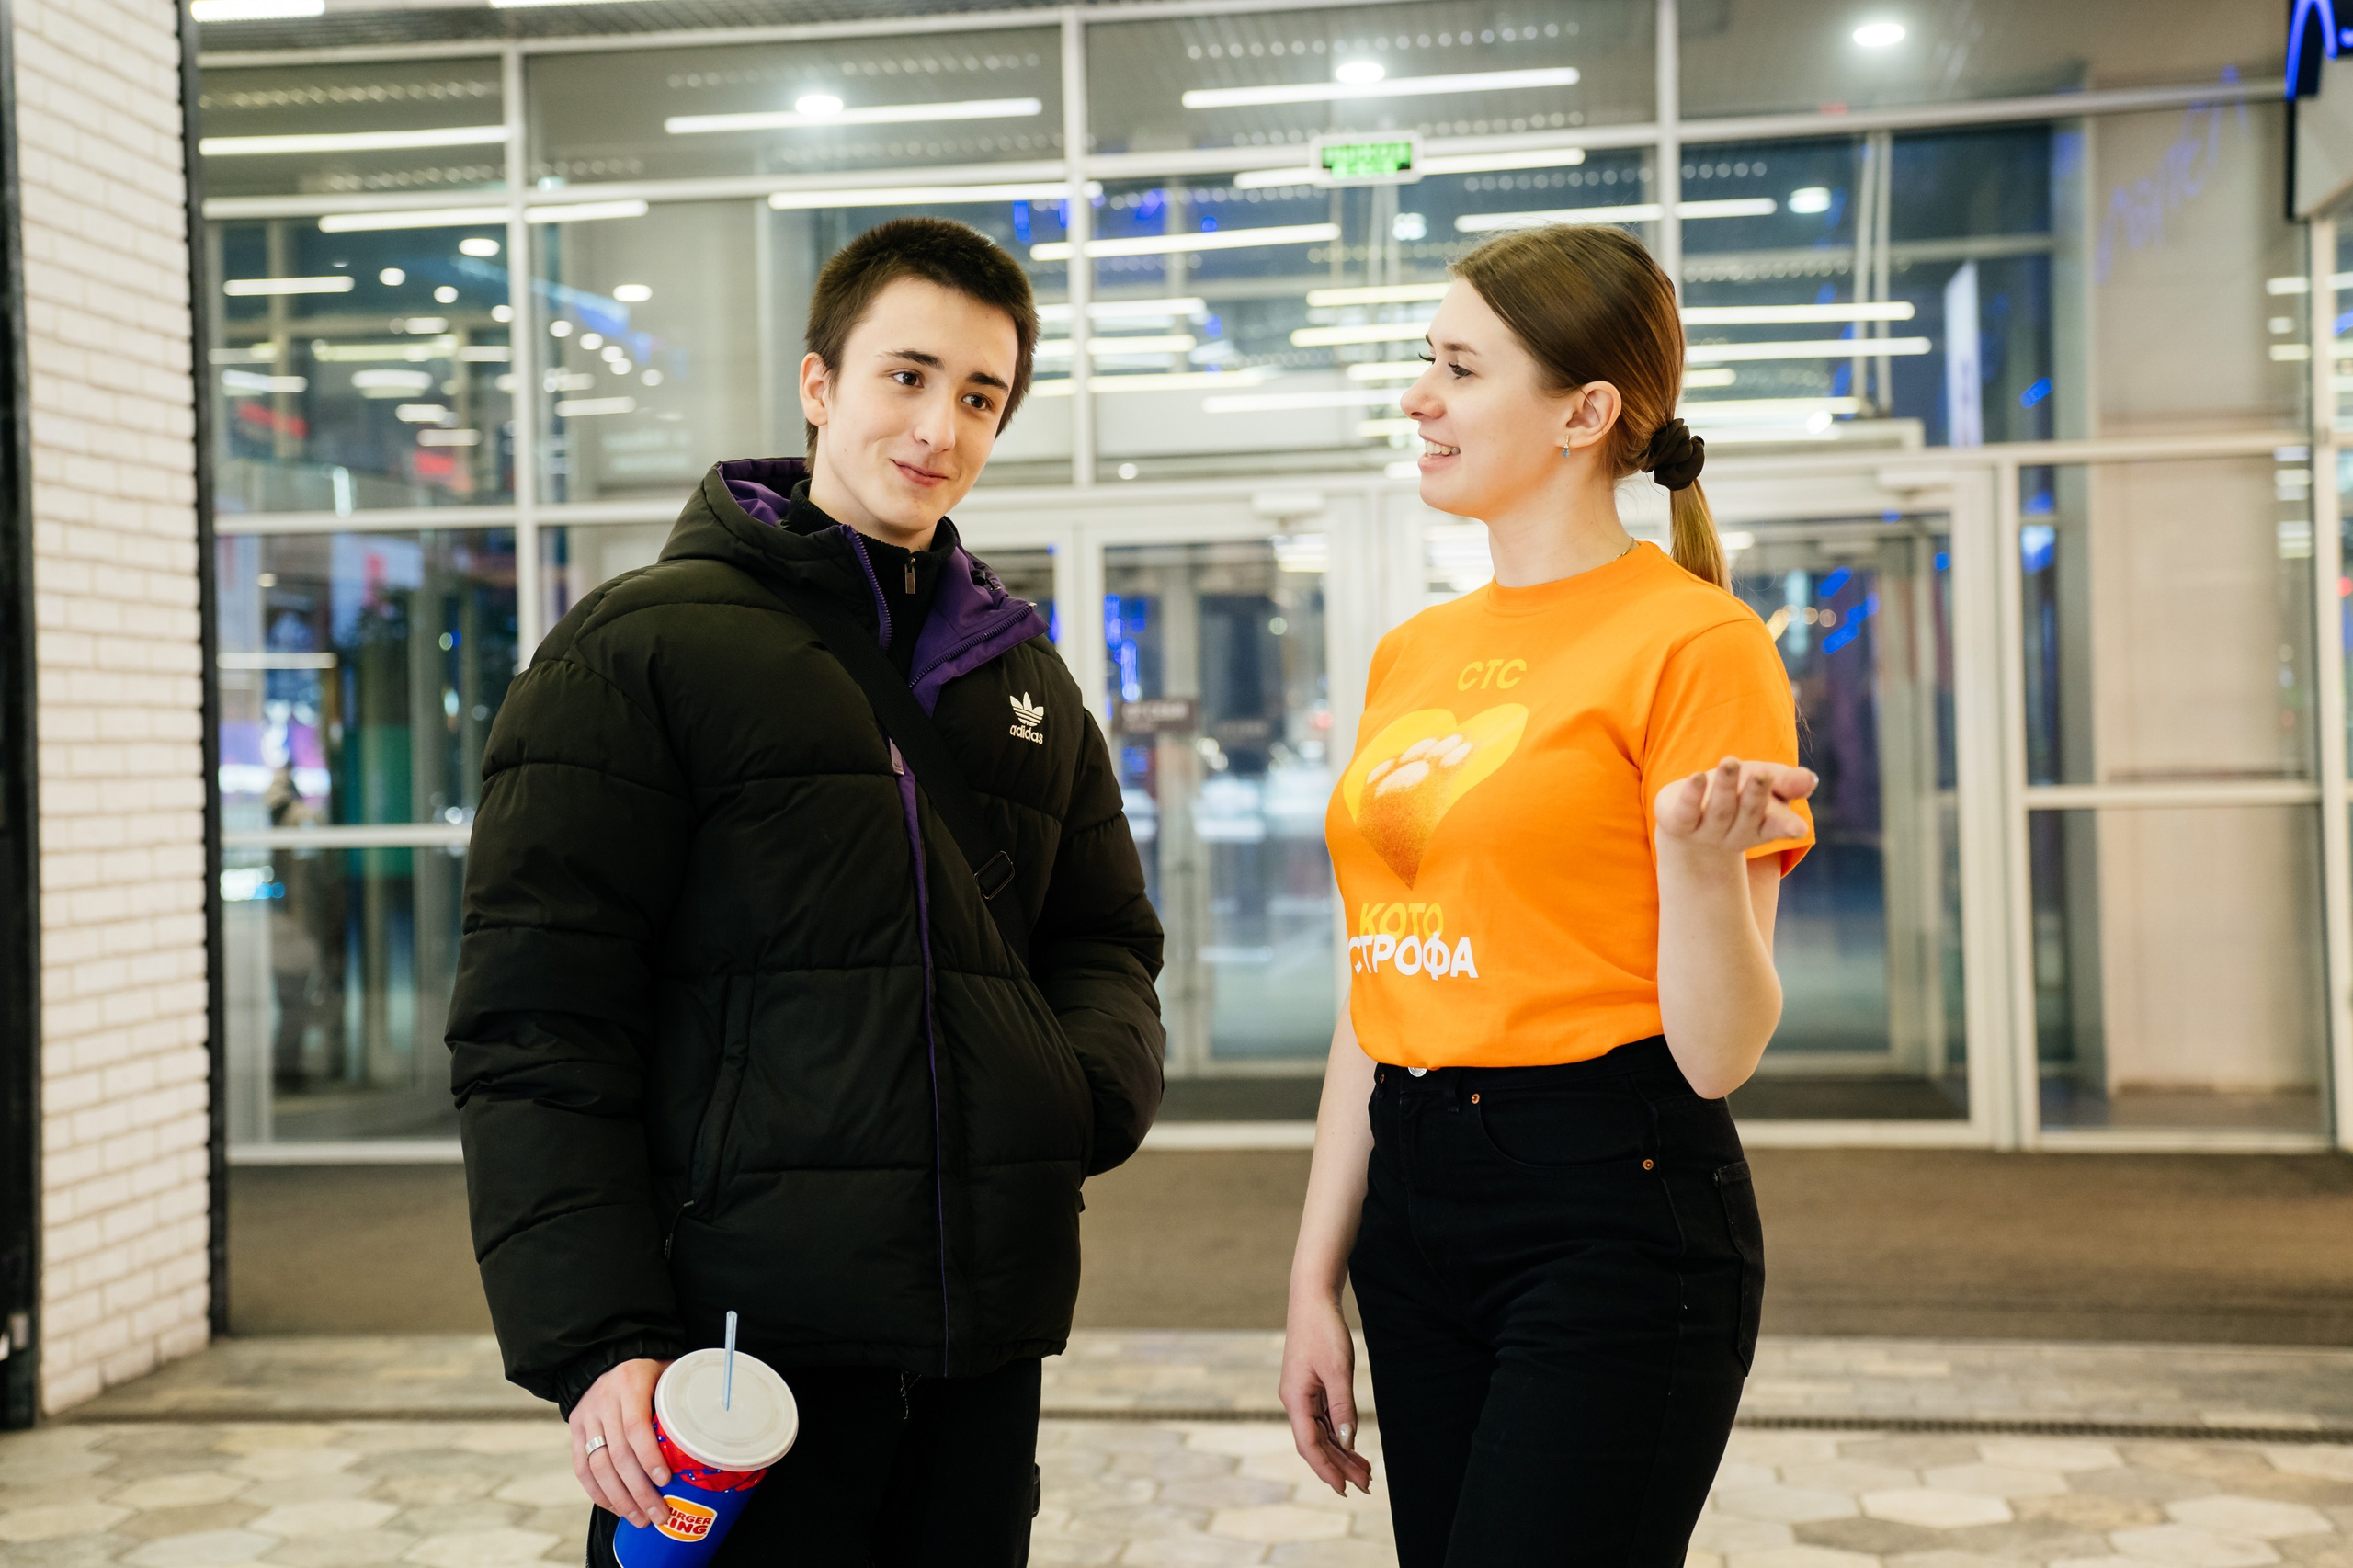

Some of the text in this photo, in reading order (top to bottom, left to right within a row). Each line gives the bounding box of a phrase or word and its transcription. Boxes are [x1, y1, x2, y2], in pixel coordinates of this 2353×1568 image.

[1457, 658, 1528, 692] СТС
[1009, 724, 1044, 744] adidas
[1359, 902, 1444, 941] КОТО
[1348, 931, 1480, 982] СТРОФА
[665, 1517, 709, 1535] ING
[668, 1506, 712, 1525] URGER
